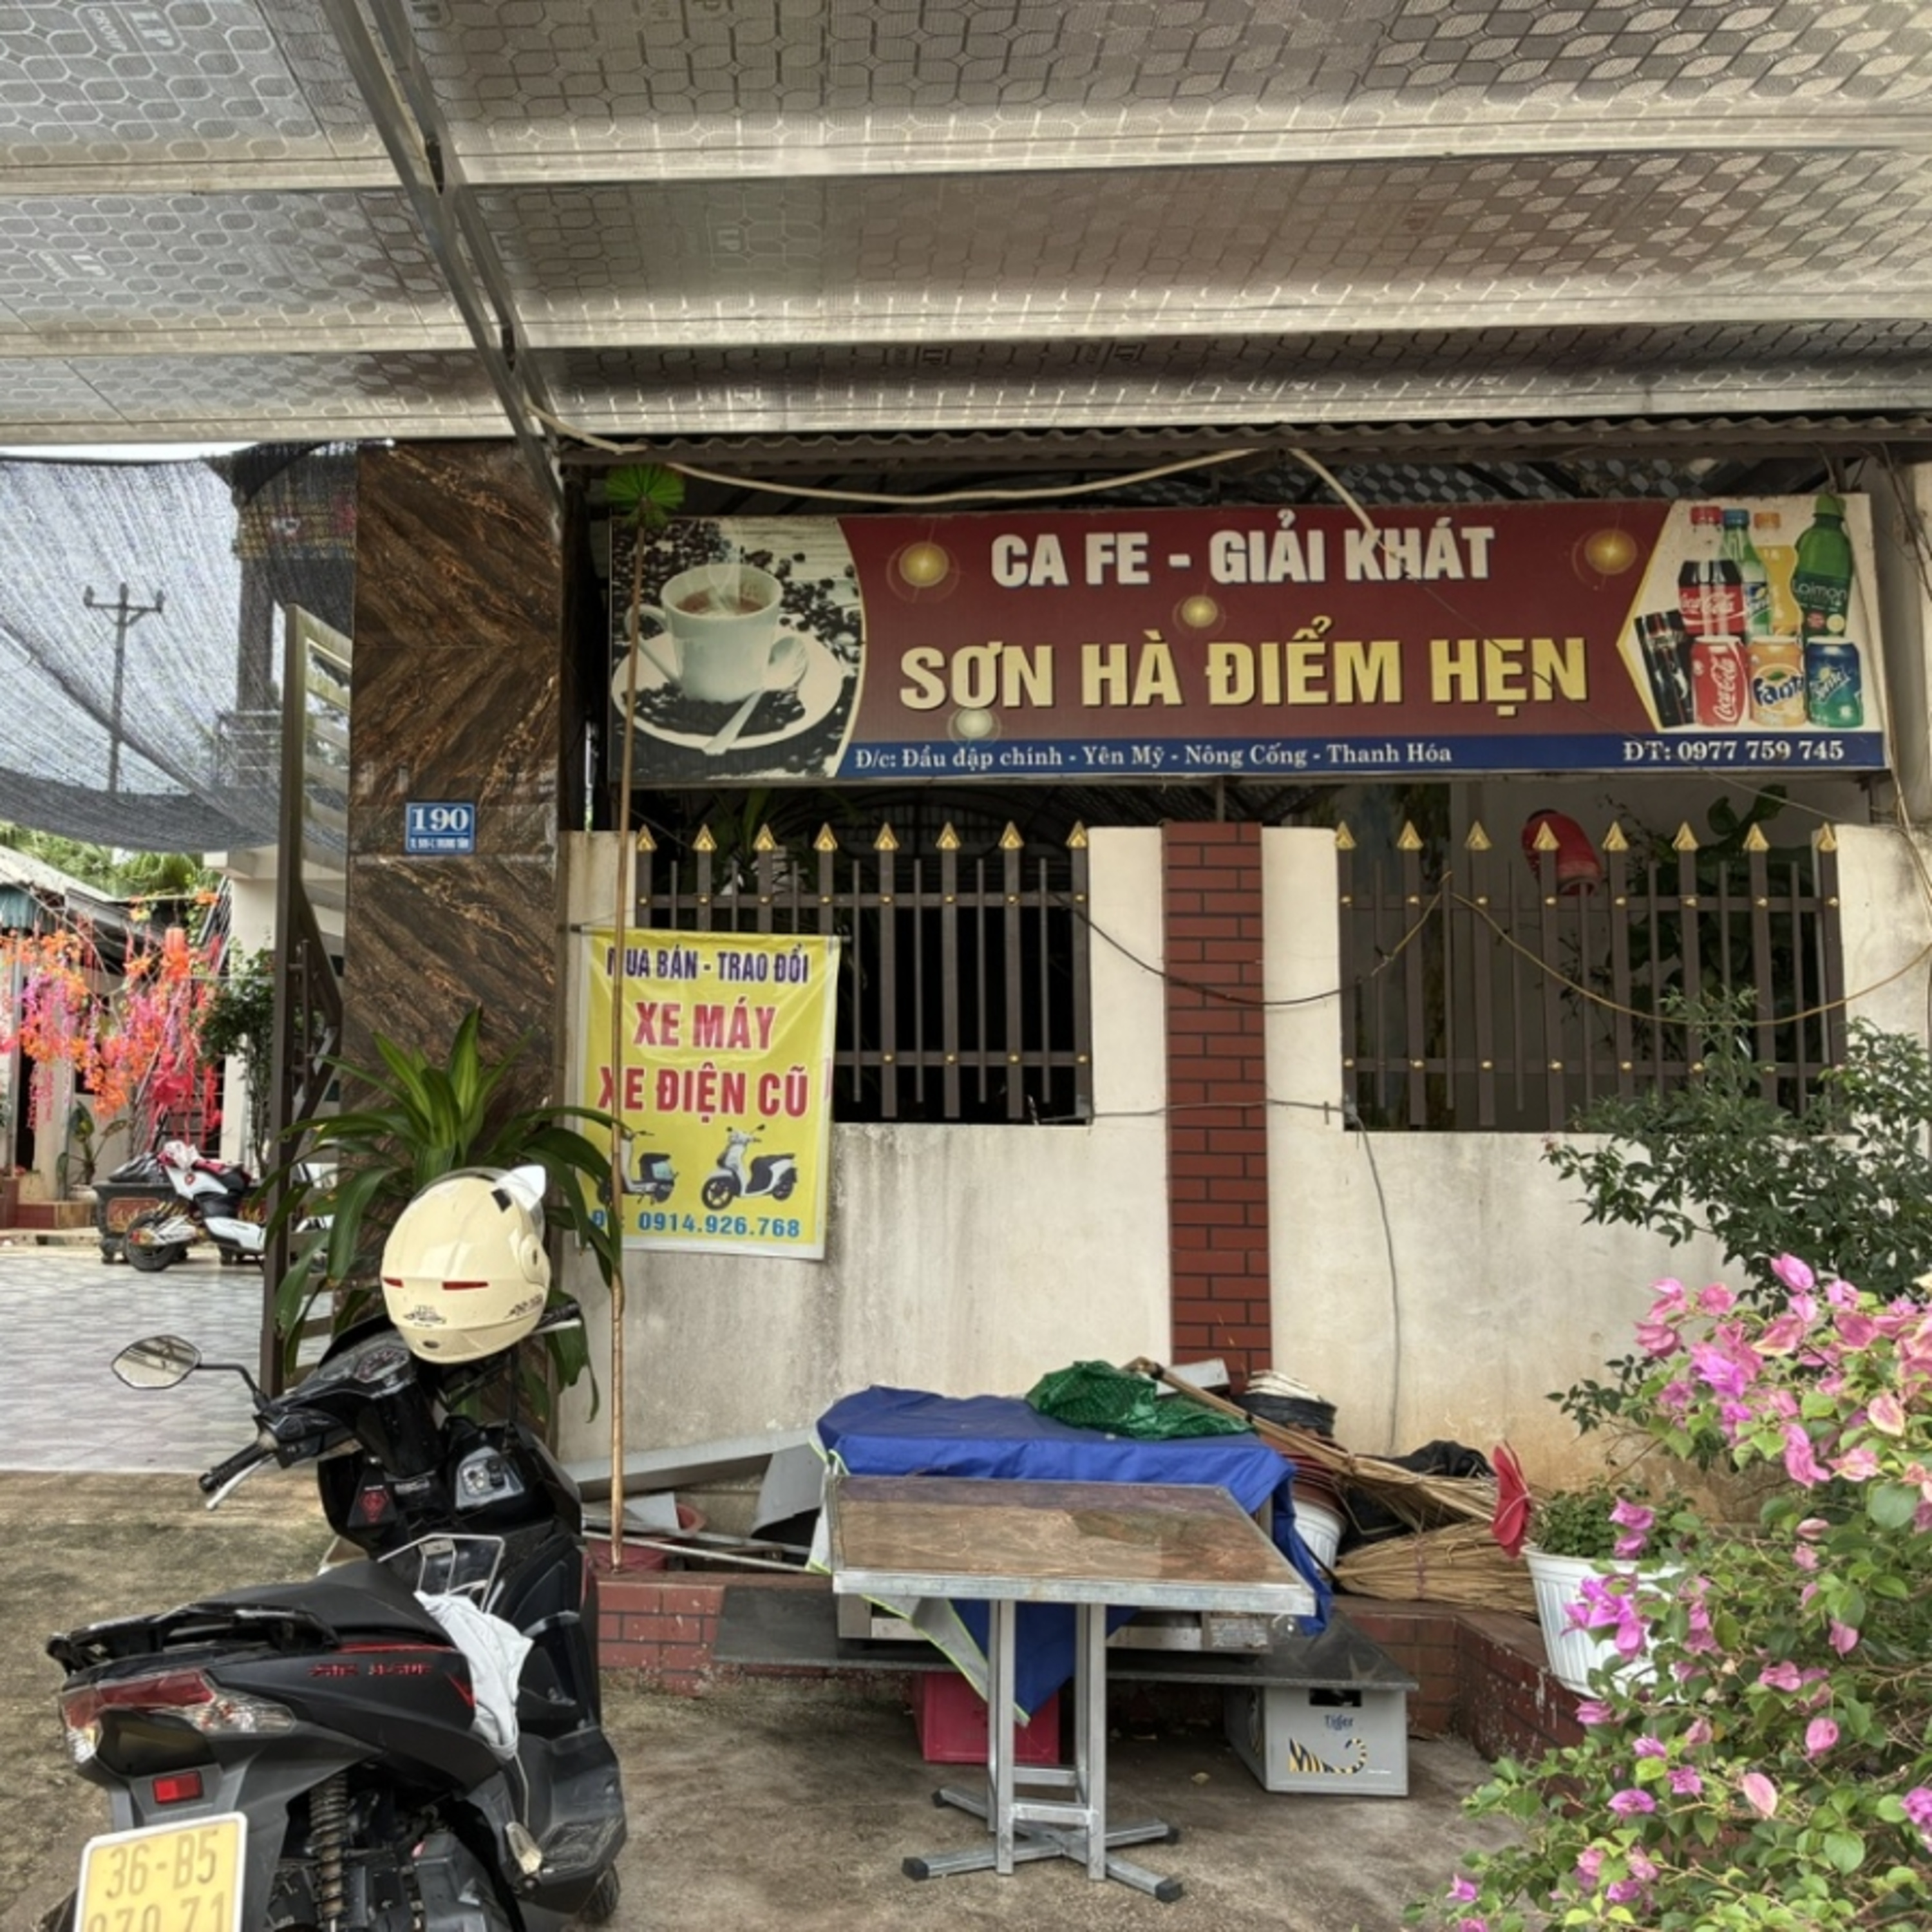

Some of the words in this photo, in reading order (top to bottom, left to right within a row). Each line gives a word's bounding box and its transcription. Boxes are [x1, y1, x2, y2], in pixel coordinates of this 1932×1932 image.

[991, 534, 1068, 587] CA
[1085, 532, 1150, 584] FE
[1169, 554, 1191, 567] -
[1209, 509, 1325, 582] GIẢI
[1344, 517, 1495, 579] KHÁT
[900, 641, 1053, 709] SƠN
[1082, 630, 1182, 706] HÀ
[1206, 616, 1401, 705] ĐIỂM
[1430, 638, 1586, 716] HẸN
[855, 749, 896, 769] Đ/c:
[952, 746, 992, 771] đập
[999, 744, 1062, 766] chính
[1082, 745, 1124, 765] Yên
[1185, 744, 1243, 766] Nông
[1250, 742, 1307, 765] Cống
[1327, 744, 1399, 762] Thanh
[1407, 741, 1452, 762] Hóa
[1624, 741, 1671, 761] ĐT:
[1678, 741, 1738, 761] 0977
[1746, 741, 1791, 760] 759
[1799, 741, 1844, 760] 745
[412, 807, 469, 831] 190
[657, 943, 698, 979] BÁN
[717, 952, 766, 982] TRAO
[774, 943, 809, 983] ĐỔI
[633, 1002, 680, 1046] XE
[693, 996, 775, 1050] MÁY
[656, 1062, 745, 1122] ĐIỆN
[759, 1066, 808, 1117] CŨ
[639, 1212, 800, 1237] 0914.926.768
[106, 1830, 218, 1900] 36-B5
